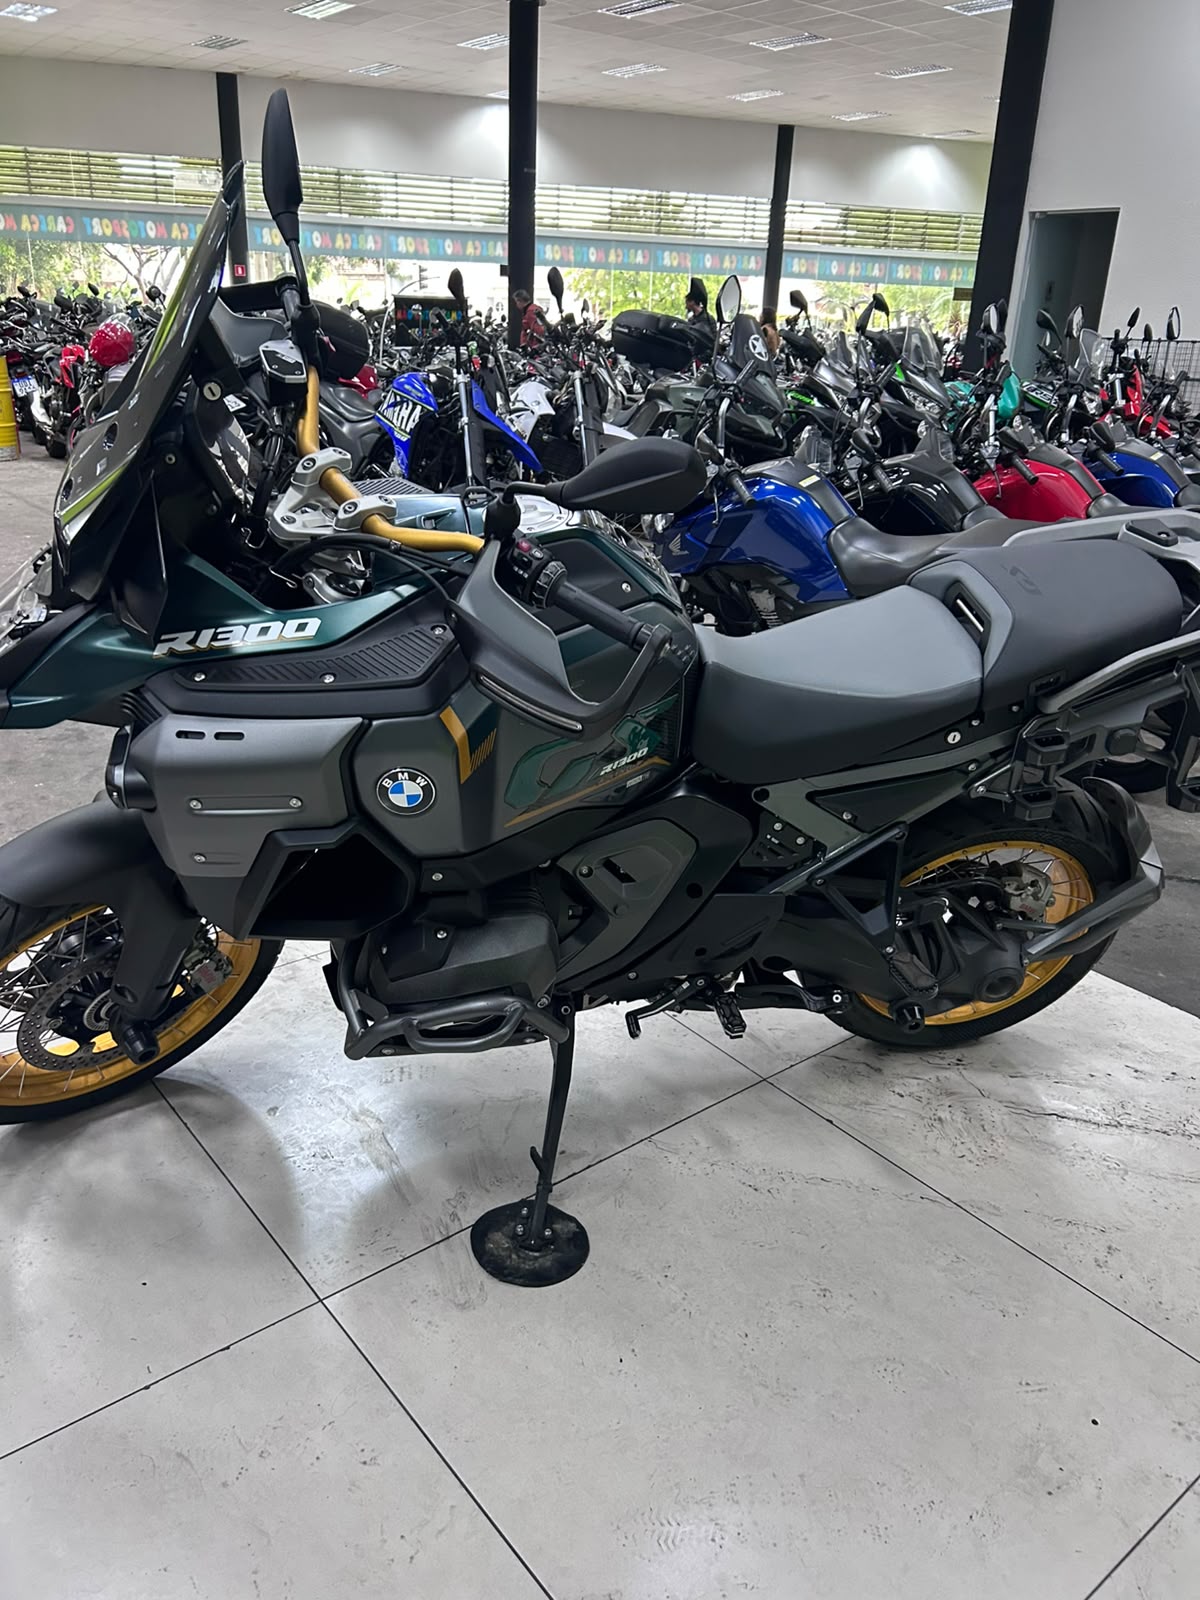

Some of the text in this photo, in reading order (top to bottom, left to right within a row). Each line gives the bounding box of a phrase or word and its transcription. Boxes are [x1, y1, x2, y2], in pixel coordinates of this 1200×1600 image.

[153, 617, 322, 659] R1300
[600, 747, 649, 776] R1300
[381, 772, 428, 788] BMW
